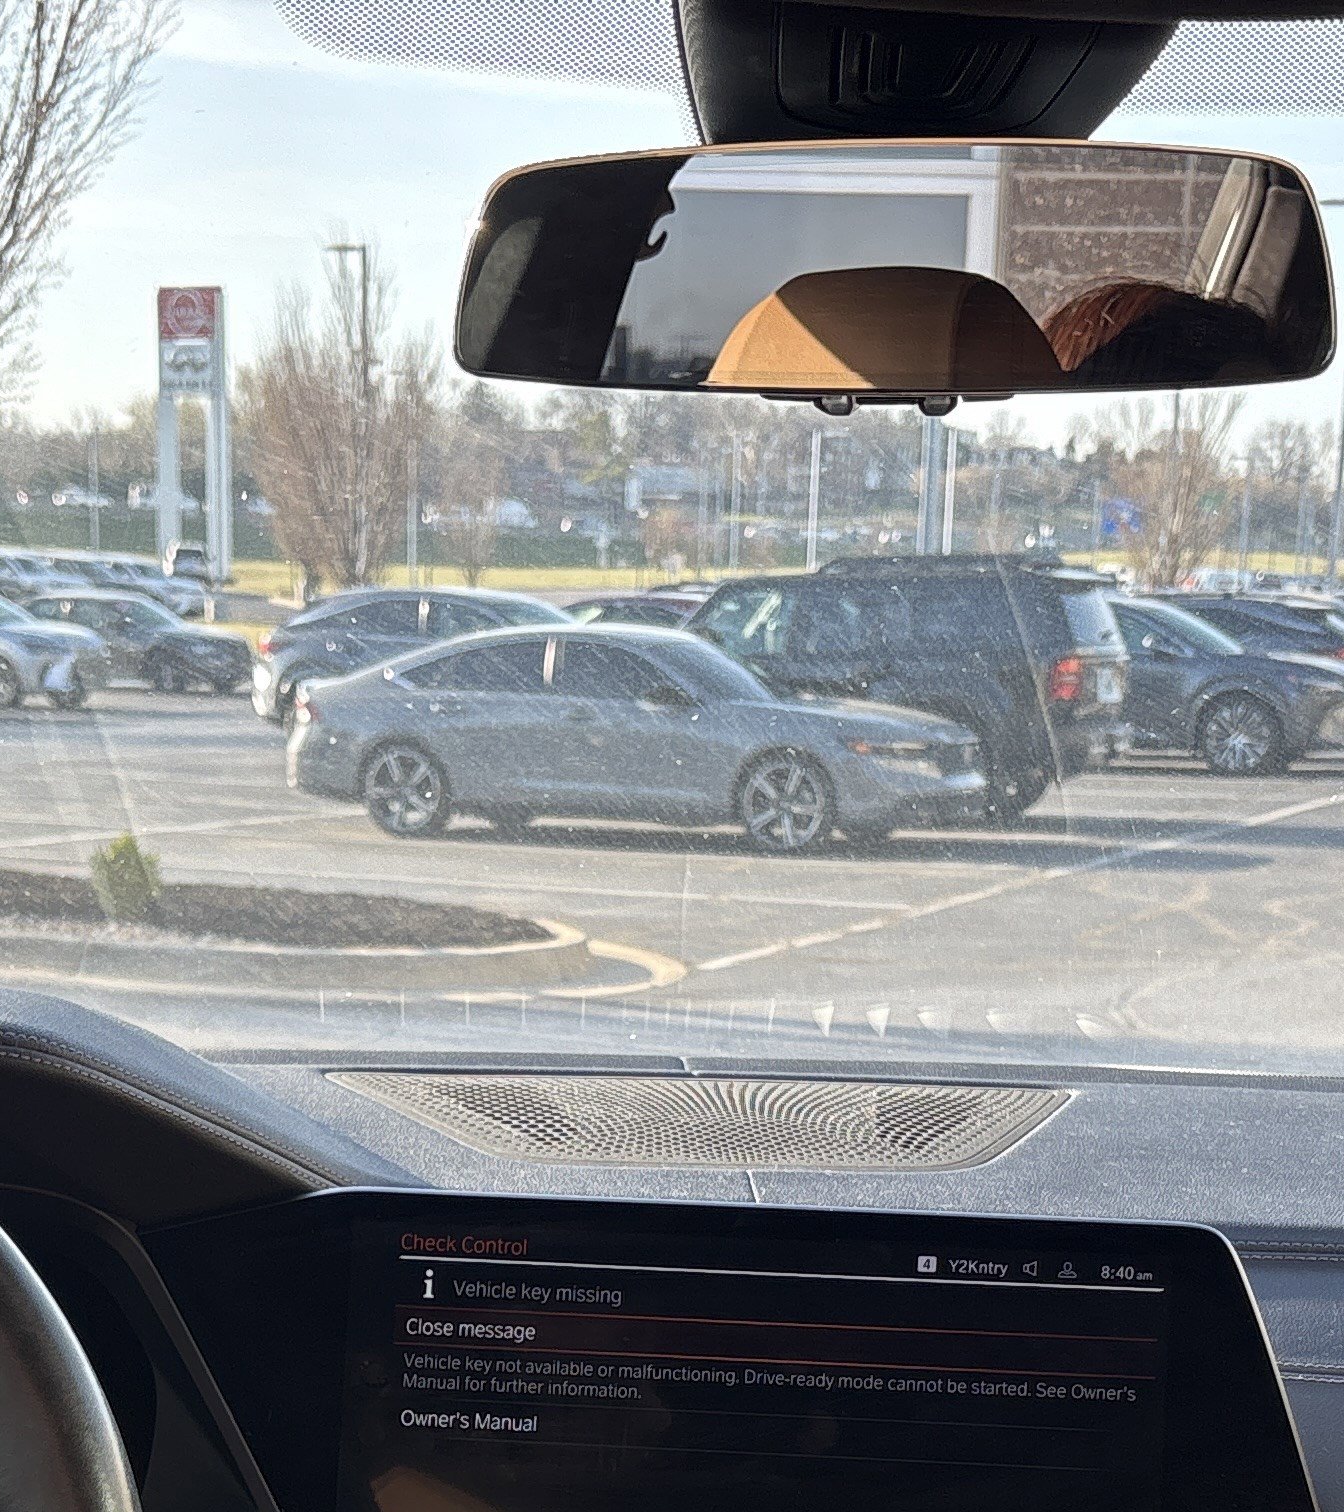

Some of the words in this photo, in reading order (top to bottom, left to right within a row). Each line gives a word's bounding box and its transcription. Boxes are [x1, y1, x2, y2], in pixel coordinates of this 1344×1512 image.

[401, 1232, 457, 1252] Check
[461, 1236, 528, 1256] Control
[948, 1259, 1008, 1278] Y2Kntry
[1101, 1265, 1134, 1280] 8:40
[453, 1280, 516, 1299] Vehicle
[522, 1282, 552, 1304] key
[556, 1285, 622, 1308] missing
[406, 1318, 454, 1337] Close
[458, 1322, 536, 1343] message
[403, 1374, 460, 1391] Manual
[464, 1376, 487, 1392] for
[491, 1377, 544, 1394] further
[548, 1380, 642, 1399] information.
[404, 1353, 461, 1370] Vehicle
[465, 1356, 492, 1375] key
[496, 1359, 522, 1373] not
[525, 1360, 593, 1377] available
[598, 1366, 615, 1378] or
[618, 1364, 740, 1387] malfunctioning.
[744, 1369, 835, 1390] Drive-ready
[838, 1375, 883, 1390] mode
[887, 1378, 943, 1393] cannot
[947, 1378, 967, 1394] be
[971, 1380, 1032, 1397] started.
[1035, 1382, 1066, 1398] See
[1071, 1383, 1137, 1401] Owner's
[400, 1409, 470, 1429] Owner's
[474, 1412, 538, 1432] Manual
